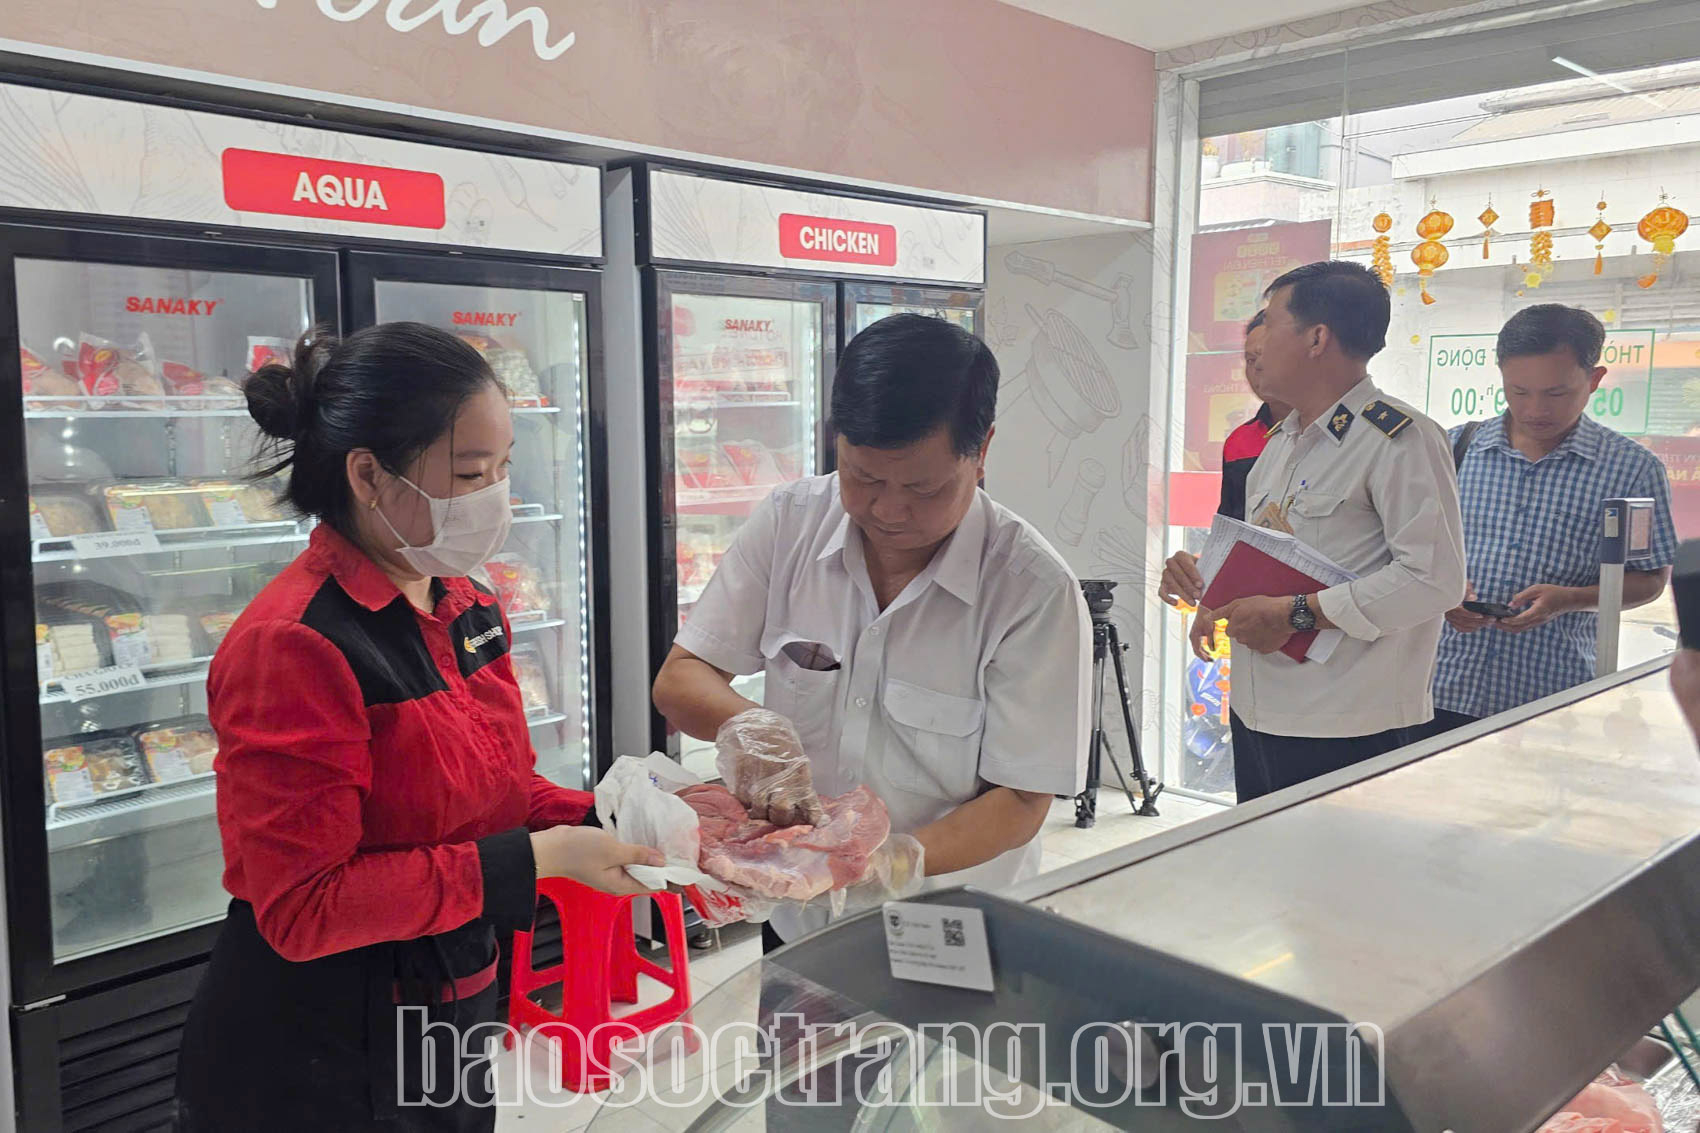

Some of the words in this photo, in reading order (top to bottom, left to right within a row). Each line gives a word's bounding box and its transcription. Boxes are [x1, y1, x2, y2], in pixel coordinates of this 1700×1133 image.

[292, 171, 389, 211] AQUA
[799, 226, 880, 256] CHICKEN
[126, 296, 217, 316] SANAKY
[452, 311, 517, 327] SANAKY
[724, 318, 773, 333] SANAKY
